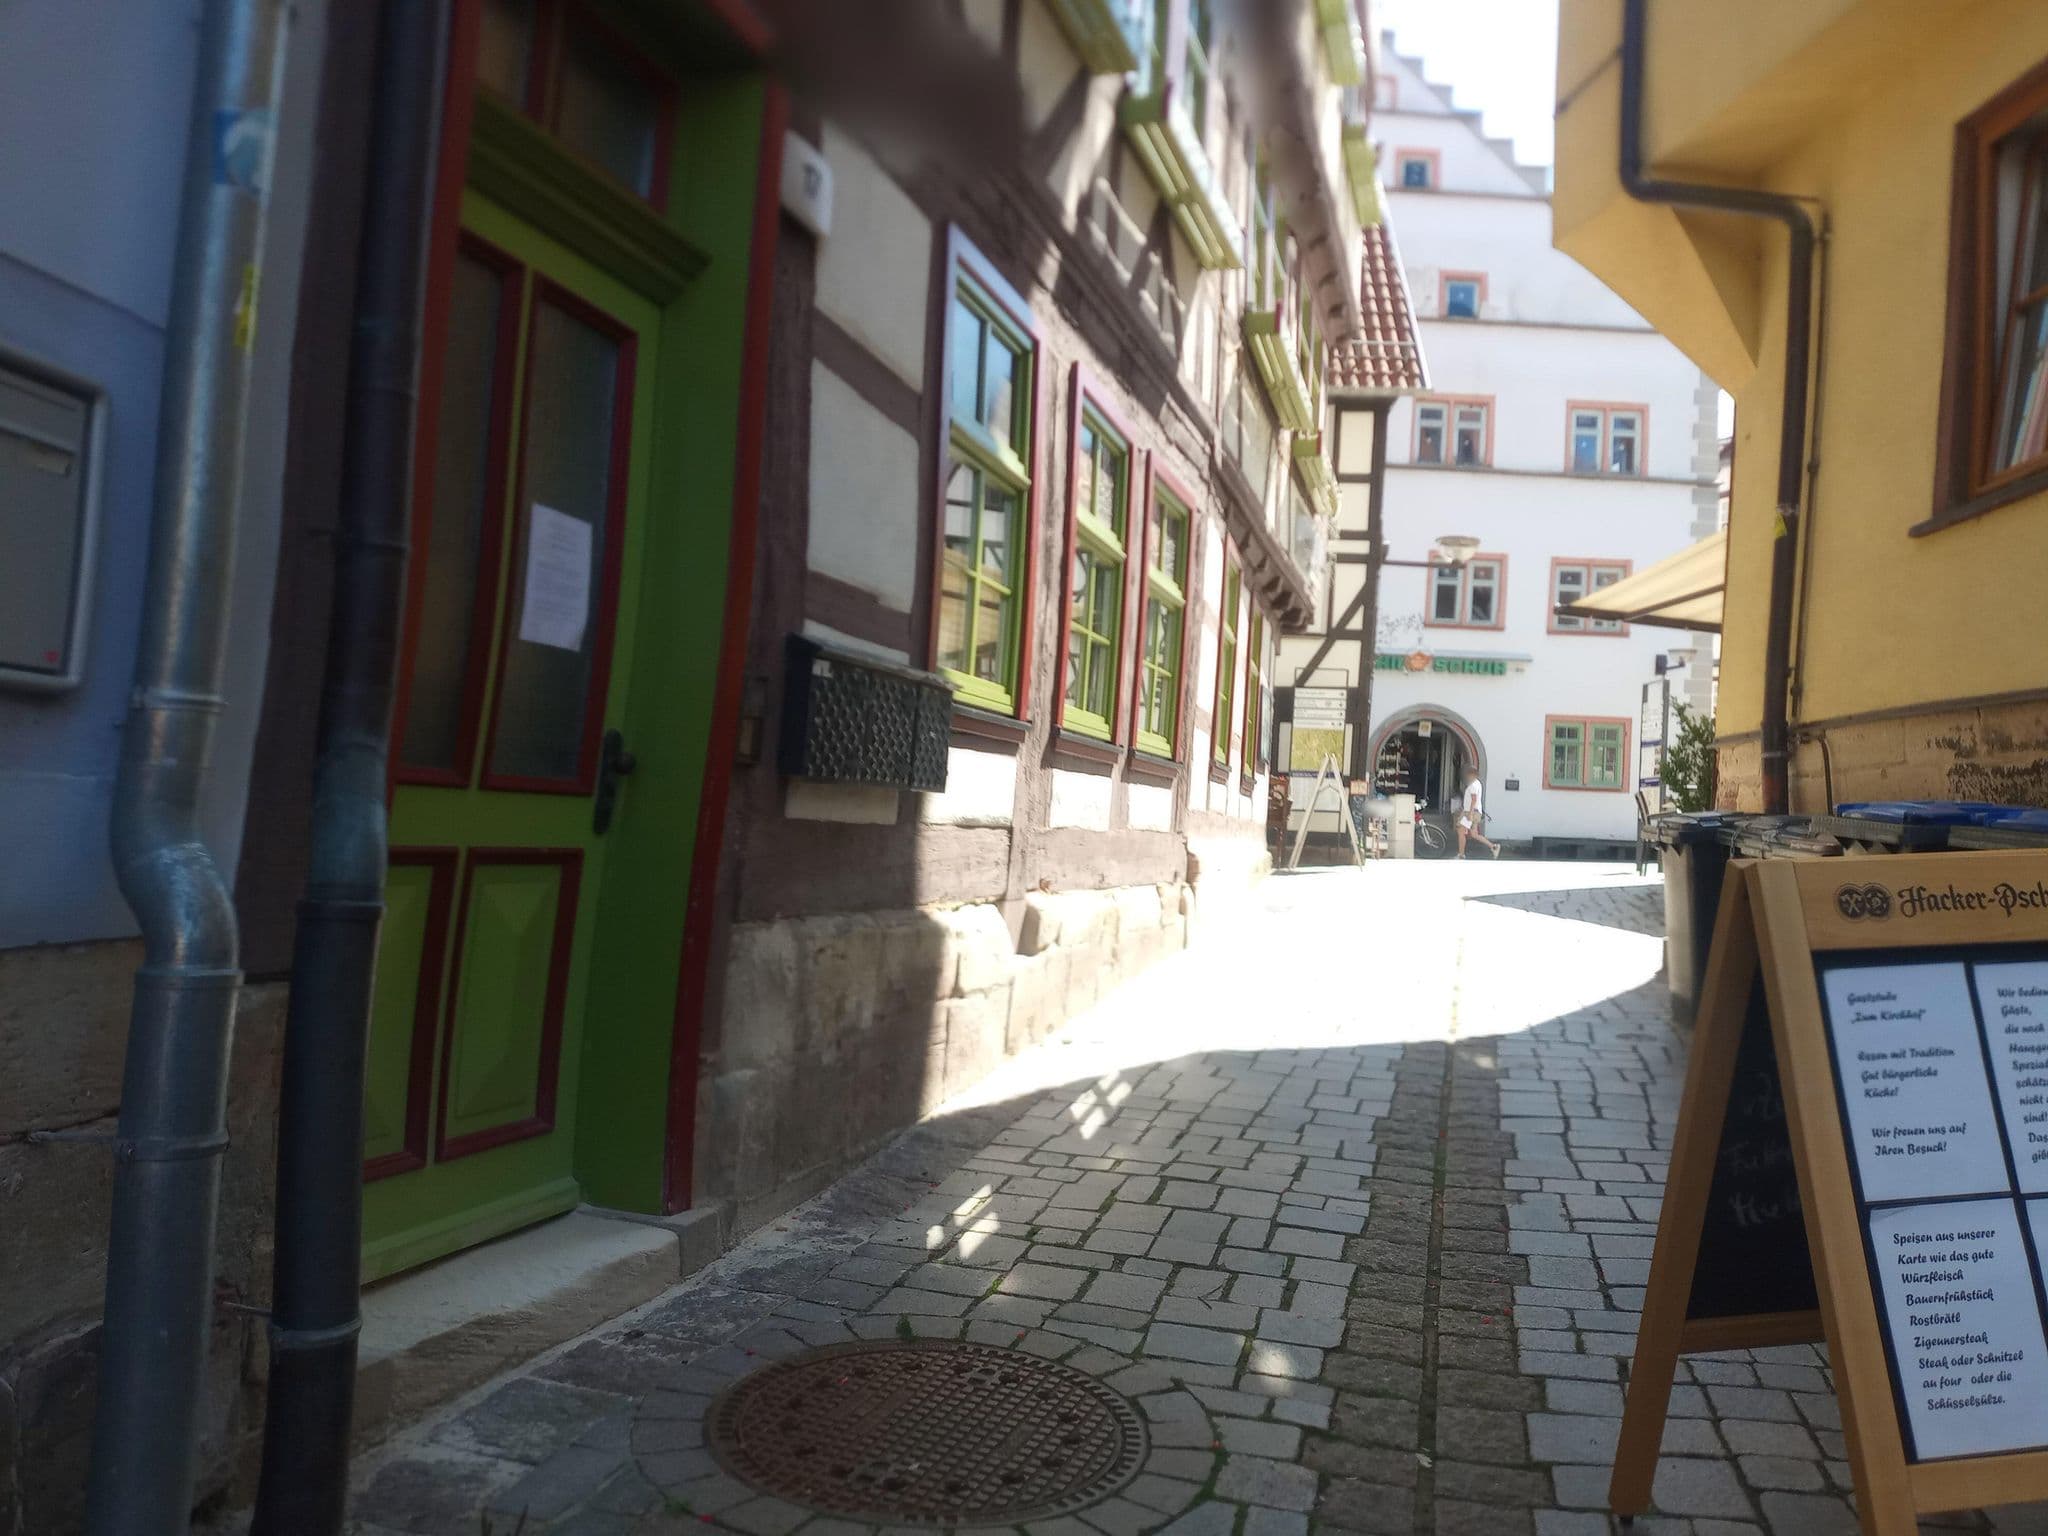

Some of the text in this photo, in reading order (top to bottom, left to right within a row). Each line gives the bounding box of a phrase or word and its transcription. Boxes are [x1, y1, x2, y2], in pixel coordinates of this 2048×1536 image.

[2005, 1023, 2019, 1034] die
[1909, 1046, 1955, 1058] Tradition
[1871, 1122, 1967, 1139] Wir freuen uns auf
[1907, 1143, 1947, 1155] Besuch!
[1893, 1229, 1996, 1246] Speisen aus unserer
[1898, 1249, 1994, 1265] Karte wie das gute
[1901, 1269, 1964, 1285] Würzfleisch
[1905, 1288, 1995, 1307] Bauernfrühstück
[1910, 1312, 1961, 1327] Rostbrätl
[1914, 1331, 1990, 1350] Zigeunersteak
[1918, 1350, 2025, 1370] Steak oder Schnitzel
[1922, 1370, 2012, 1389] au four oder die
